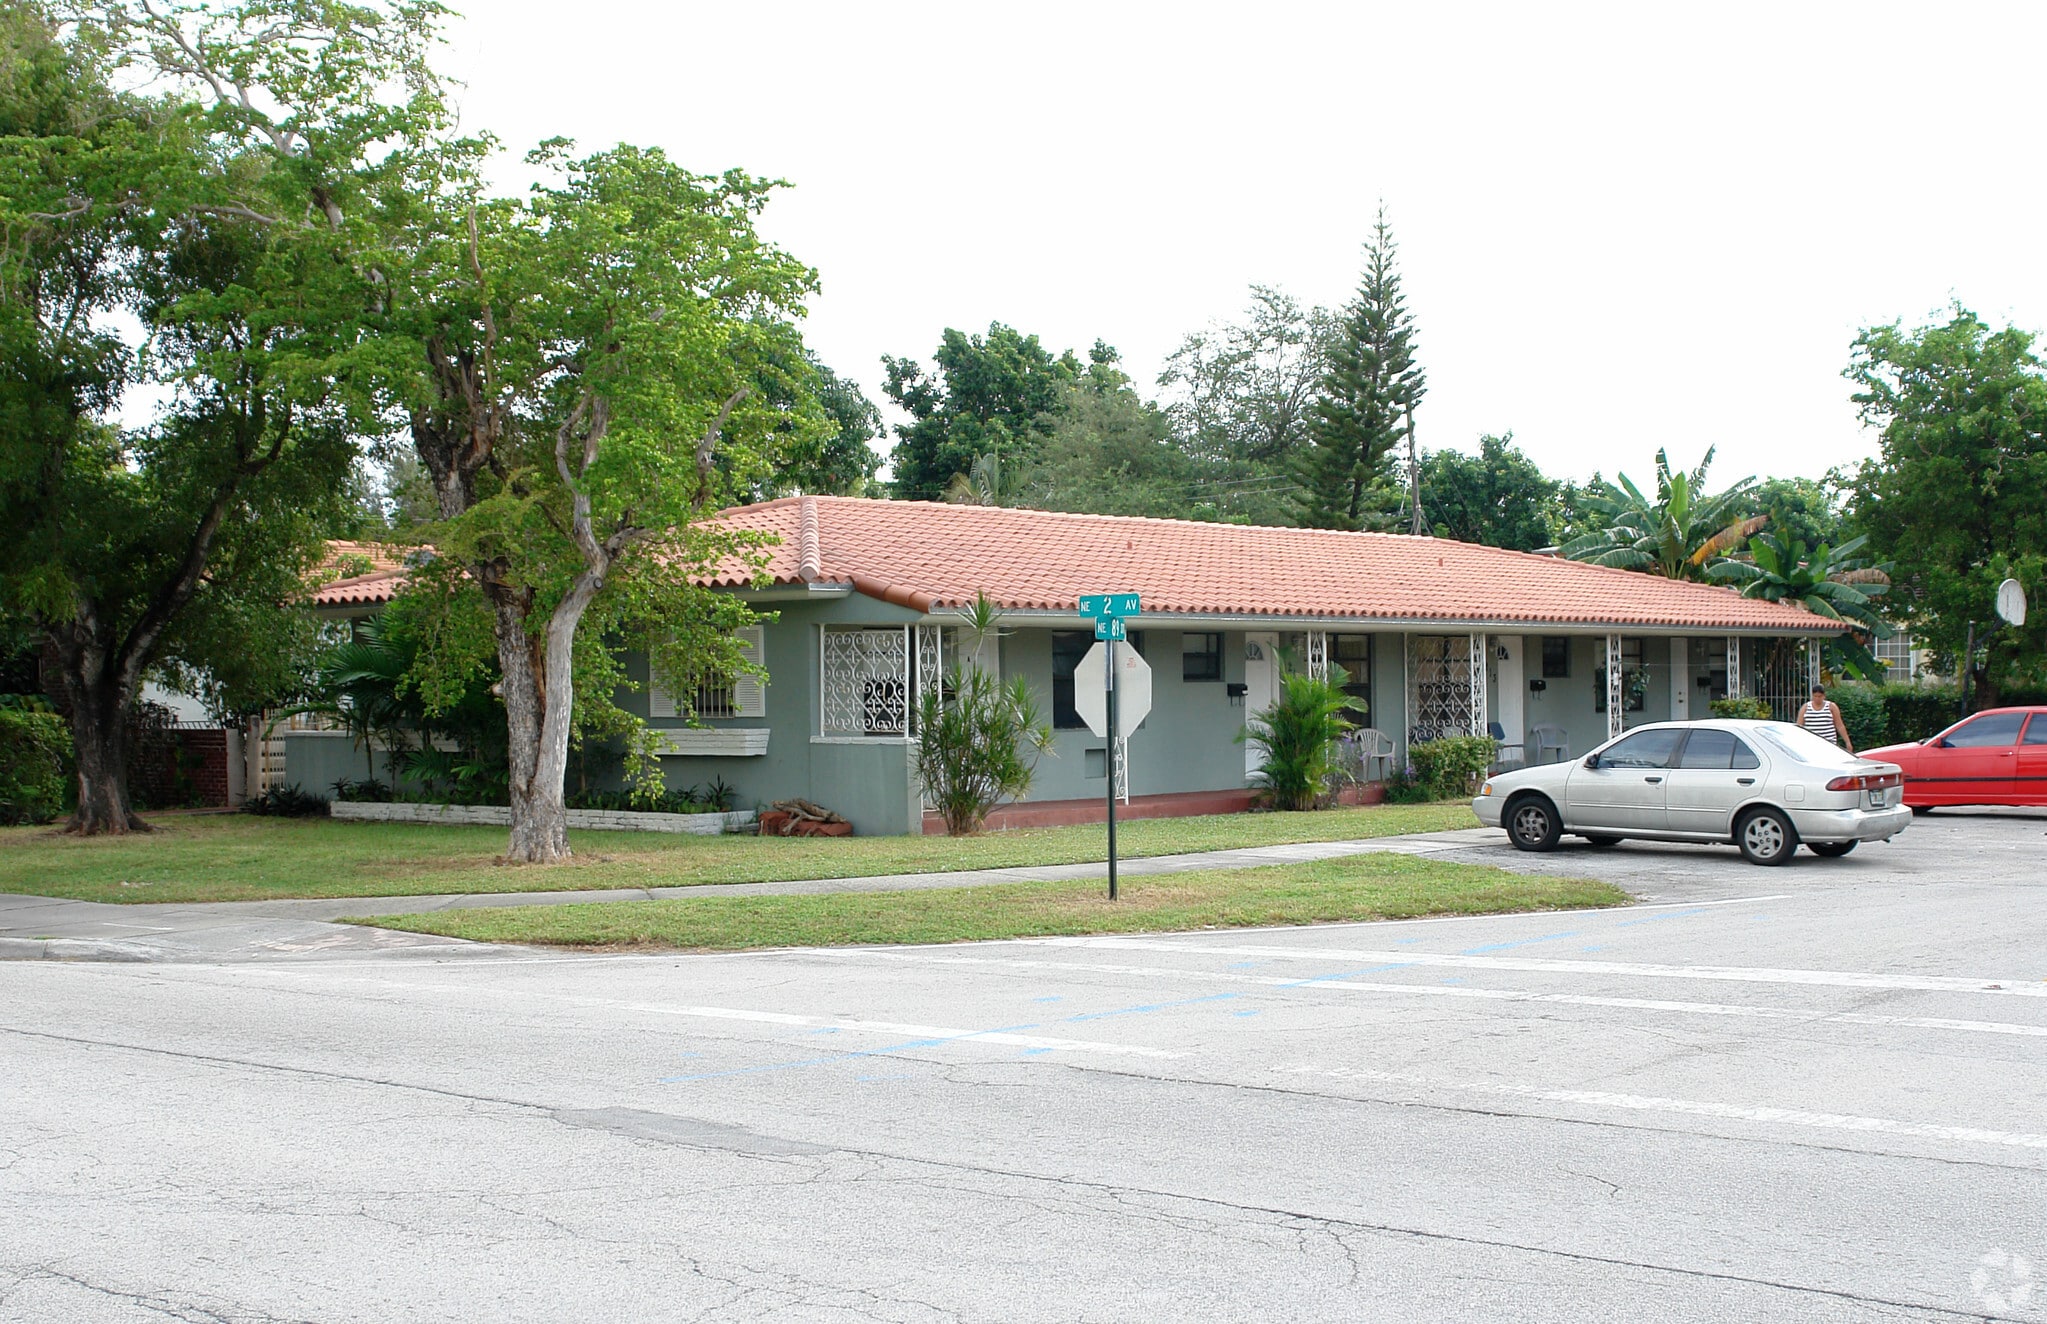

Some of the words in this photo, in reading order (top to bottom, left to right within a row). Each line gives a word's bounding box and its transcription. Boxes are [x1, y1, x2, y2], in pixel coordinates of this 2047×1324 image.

[1080, 601, 1091, 612] NE
[1103, 596, 1112, 615] 2
[1125, 599, 1137, 611] AV
[1097, 622, 1107, 634] NE
